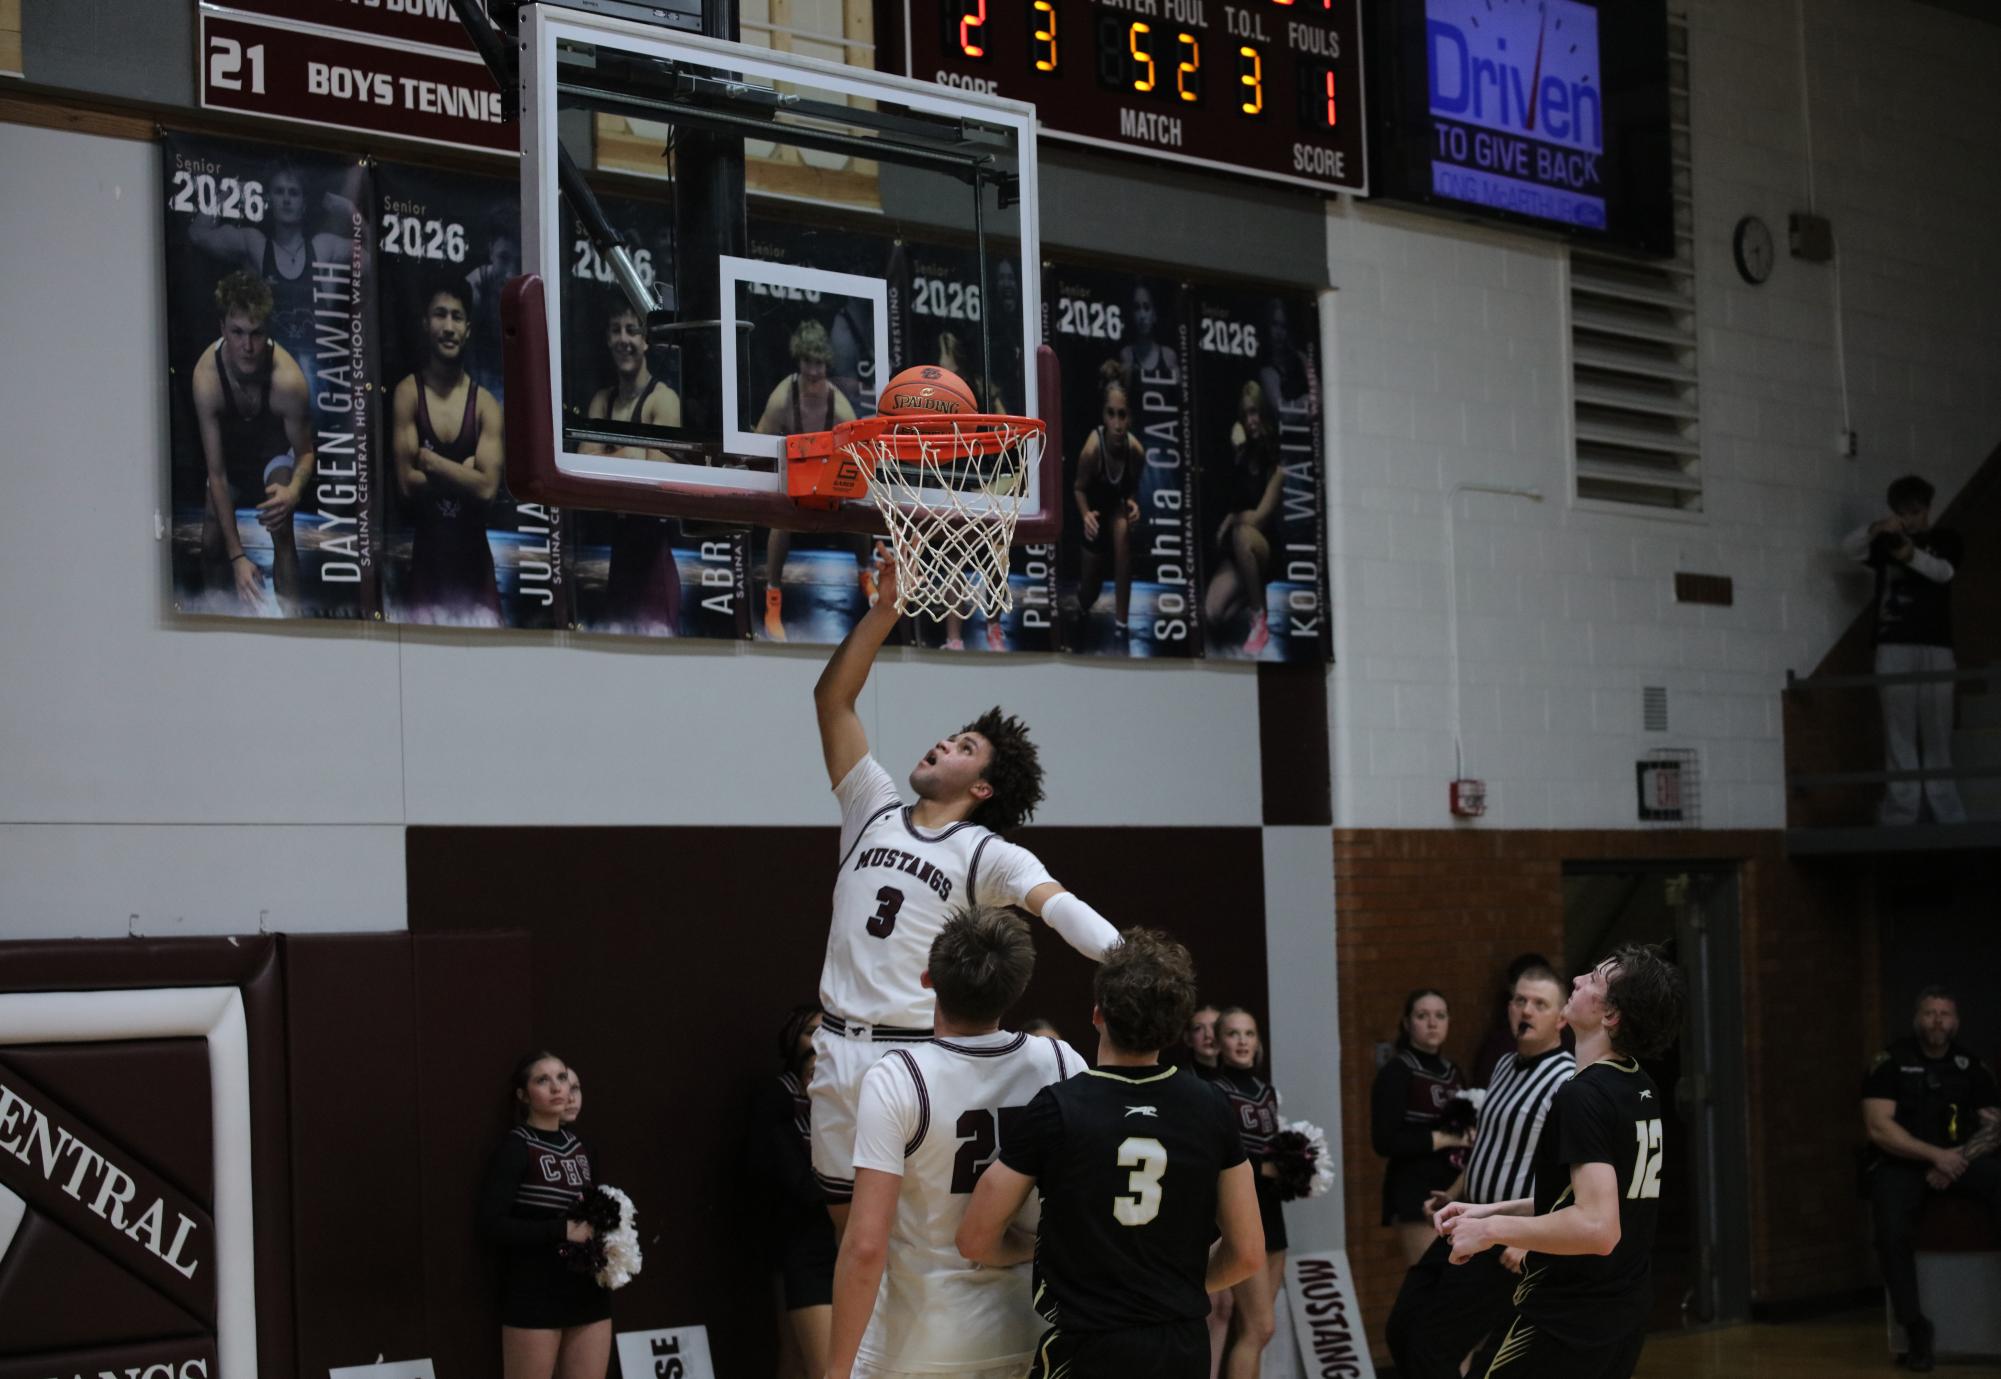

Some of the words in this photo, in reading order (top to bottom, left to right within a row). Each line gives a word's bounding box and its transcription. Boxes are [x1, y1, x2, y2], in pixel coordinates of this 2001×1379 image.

[1033, 0, 1057, 72] 3
[1164, 0, 1209, 28] FOUL
[1224, 5, 1271, 43] T.O.L.
[1288, 21, 1341, 59] FOULS
[209, 36, 266, 95] 21
[307, 61, 393, 107] BOYS
[400, 76, 503, 124] TENNIS
[1239, 46, 1263, 115] 3
[1324, 69, 1337, 128] 1
[1120, 107, 1183, 147] MATCH
[1433, 122, 1468, 162] TO
[1475, 132, 1529, 176] GIVE
[1536, 147, 1600, 188] BACK
[175, 153, 222, 174] Senior
[1292, 142, 1345, 178] SCORE
[169, 170, 267, 223] 2026
[384, 195, 427, 216] Senior
[352, 213, 363, 305] WRESTLING
[380, 213, 468, 264] 2026
[573, 240, 655, 288] 206
[911, 277, 981, 322] 2026
[1057, 298, 1124, 341] 2026
[312, 262, 354, 413] GAWITH
[352, 312, 364, 379] SCHOOL
[1199, 318, 1259, 358] 2026
[354, 385, 367, 427] HIGH
[893, 394, 960, 414] SPALDING
[1141, 368, 1182, 469] CAPE
[356, 433, 369, 503] CENTRAL
[1279, 399, 1316, 521] WAITE
[316, 431, 363, 582] DAYGEN
[358, 509, 371, 567] SALINA
[552, 530, 562, 585] SALINA
[1149, 489, 1188, 641] Sophia
[1185, 514, 1196, 574] CENTRAL
[701, 535, 735, 616] ABR
[734, 543, 745, 600] SALINA
[1285, 543, 1320, 638] KODI
[1187, 578, 1198, 627] SALINA
[854, 847, 953, 902] MUSTANGS
[866, 885, 905, 939] 3
[0, 1084, 199, 1280] ENTRAL
[1113, 1136, 1169, 1226] 3
[1625, 1118, 1664, 1200] 12
